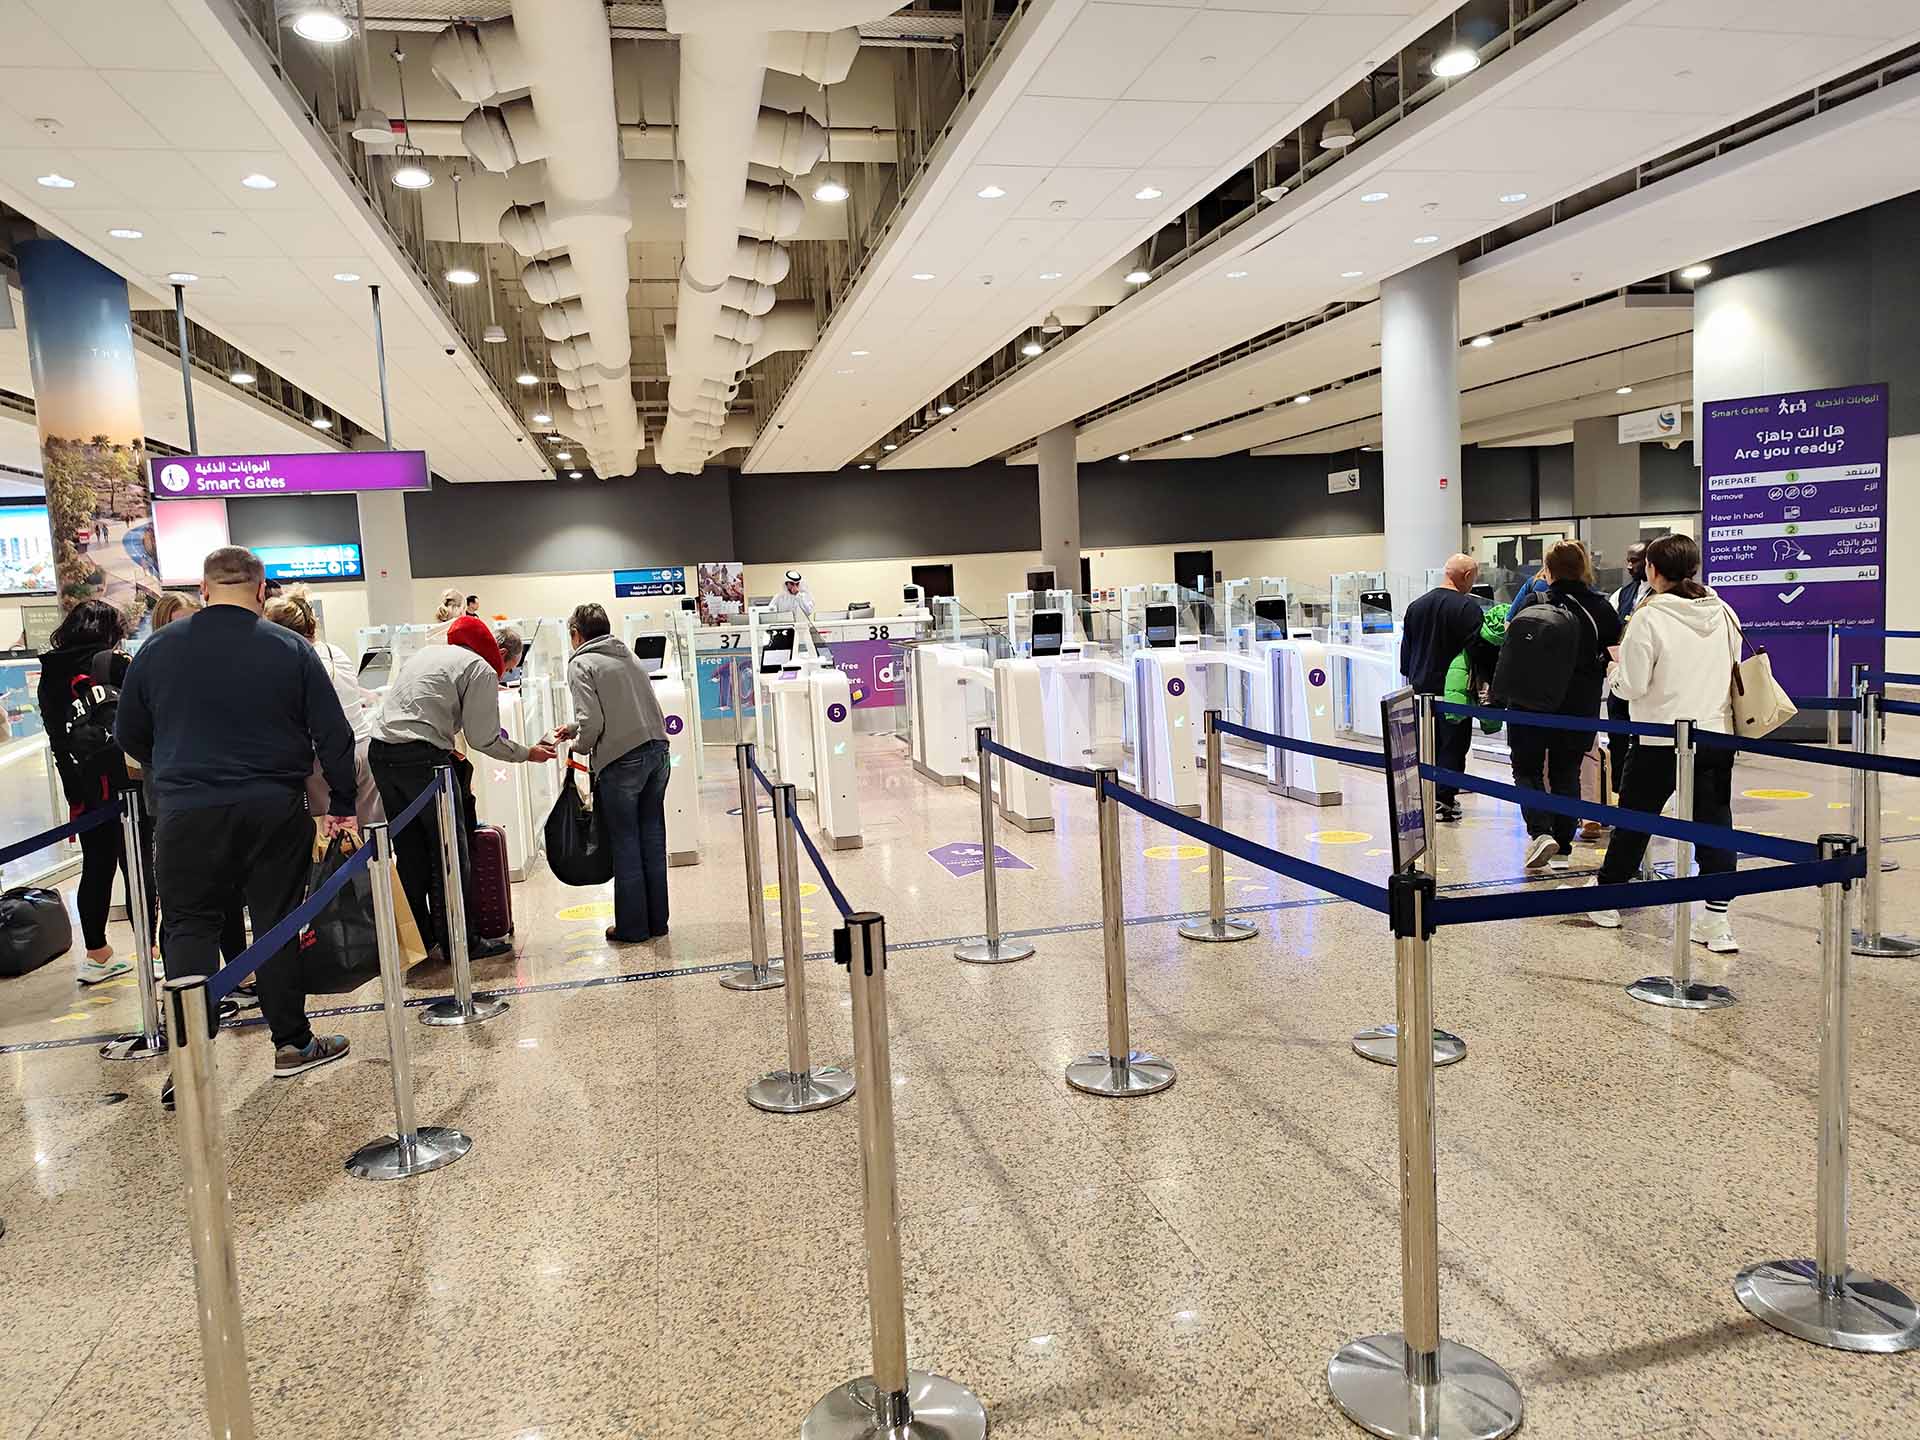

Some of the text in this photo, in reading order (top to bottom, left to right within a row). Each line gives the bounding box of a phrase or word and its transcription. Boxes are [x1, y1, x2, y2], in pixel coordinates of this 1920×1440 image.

[1711, 406, 1770, 418] Smart Gates
[1823, 425, 1845, 437] هل
[1756, 430, 1793, 444] جاهز؟
[1734, 440, 1845, 460] Are you ready?
[194, 459, 270, 475] البوابات الذكية
[196, 475, 286, 491] Smart Gates
[1711, 476, 1757, 486] PREPARE
[1711, 493, 1744, 501] Remove
[1744, 511, 1764, 519] hand
[1711, 529, 1744, 537] ENTER
[1711, 546, 1730, 554] Look
[1711, 552, 1754, 562] green light
[1711, 574, 1758, 583] PROCEED
[868, 625, 890, 640] 38
[720, 634, 741, 649] 37
[700, 657, 722, 665] Free
[842, 662, 859, 670] free
[1314, 673, 1321, 682] 7
[1173, 682, 1180, 691] 6
[834, 708, 841, 718] 5
[669, 720, 677, 730] 4
[604, 963, 736, 984] Please wait here
[340, 1004, 379, 1015] wait
